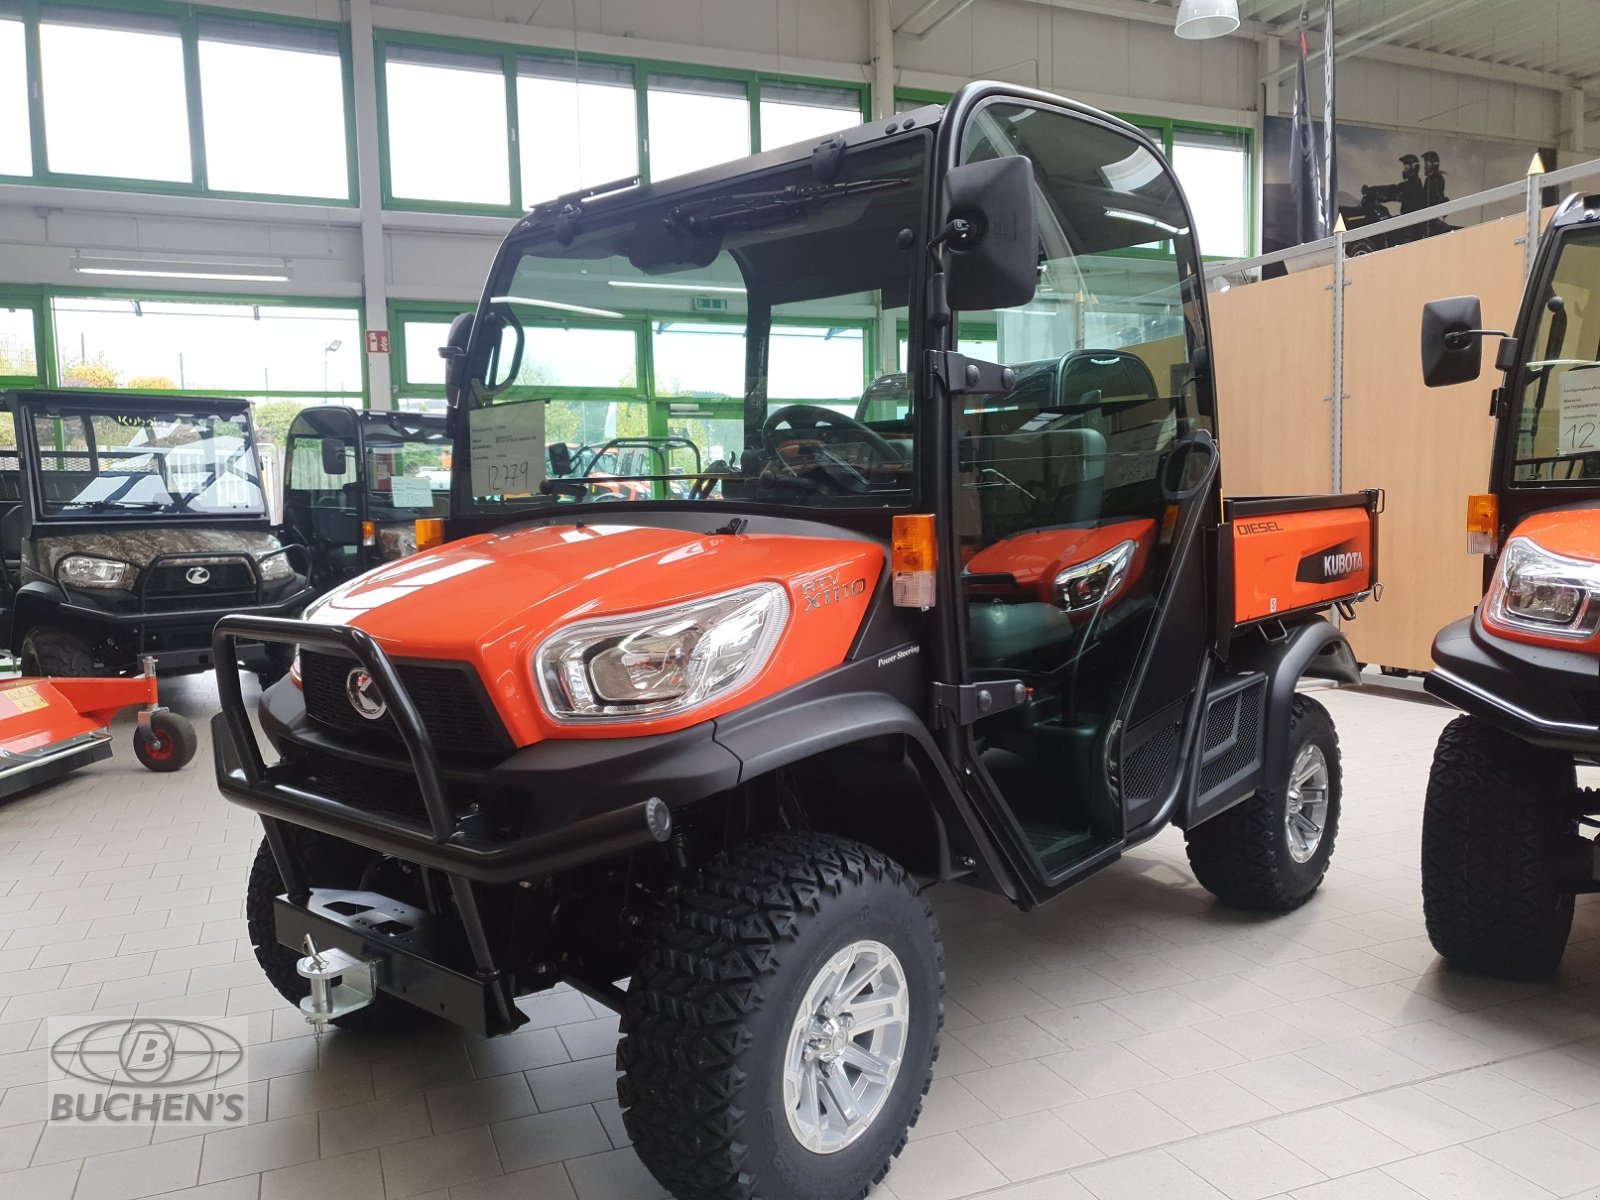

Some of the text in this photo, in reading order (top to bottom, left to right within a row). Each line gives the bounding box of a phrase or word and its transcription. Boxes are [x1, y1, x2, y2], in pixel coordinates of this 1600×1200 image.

[1564, 421, 1600, 449] 12
[488, 461, 529, 491] 12779
[1236, 521, 1284, 535] DIESEL
[1323, 552, 1363, 576] KUBOTA
[801, 573, 840, 594] RTV
[878, 645, 920, 667] Power Steering
